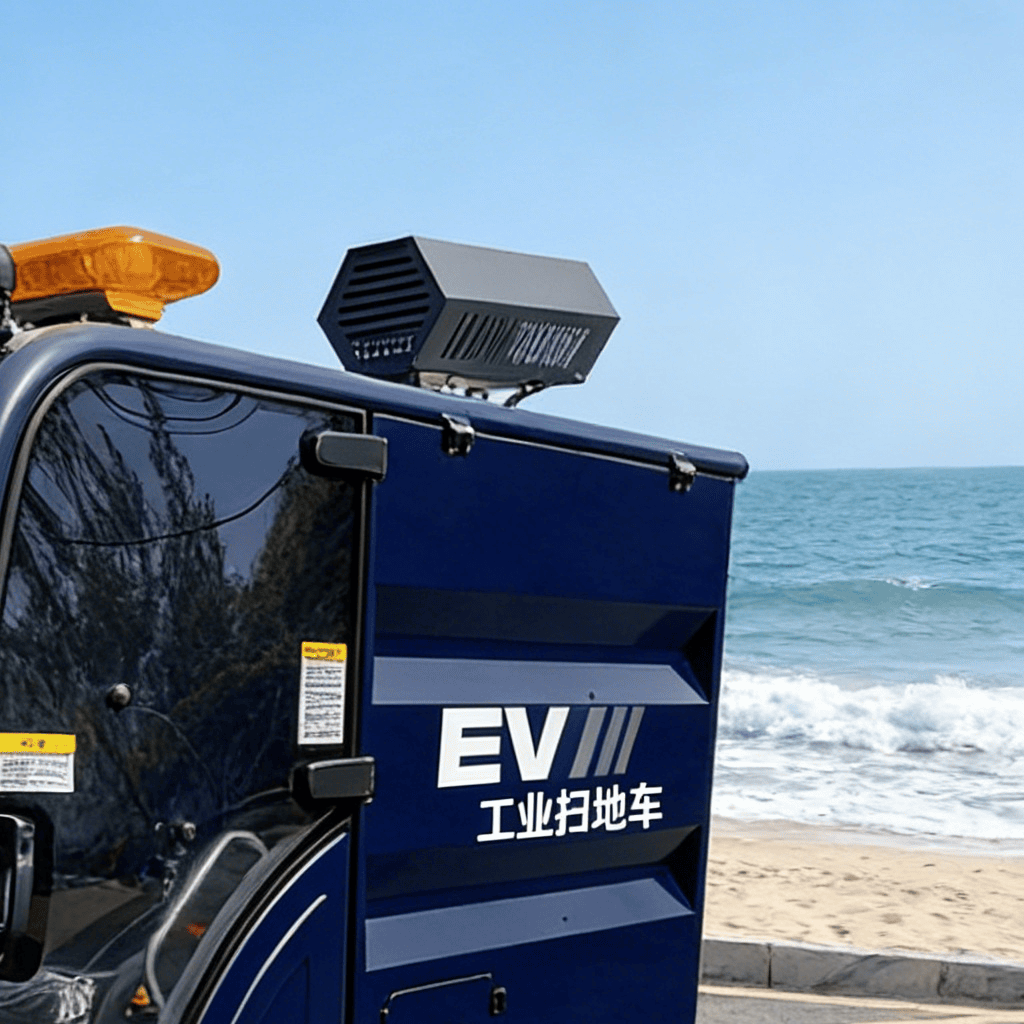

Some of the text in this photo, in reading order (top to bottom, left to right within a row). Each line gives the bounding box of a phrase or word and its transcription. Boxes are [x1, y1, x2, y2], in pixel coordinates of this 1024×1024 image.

[437, 706, 570, 788] EV
[477, 782, 663, 842] 工业扫地车
